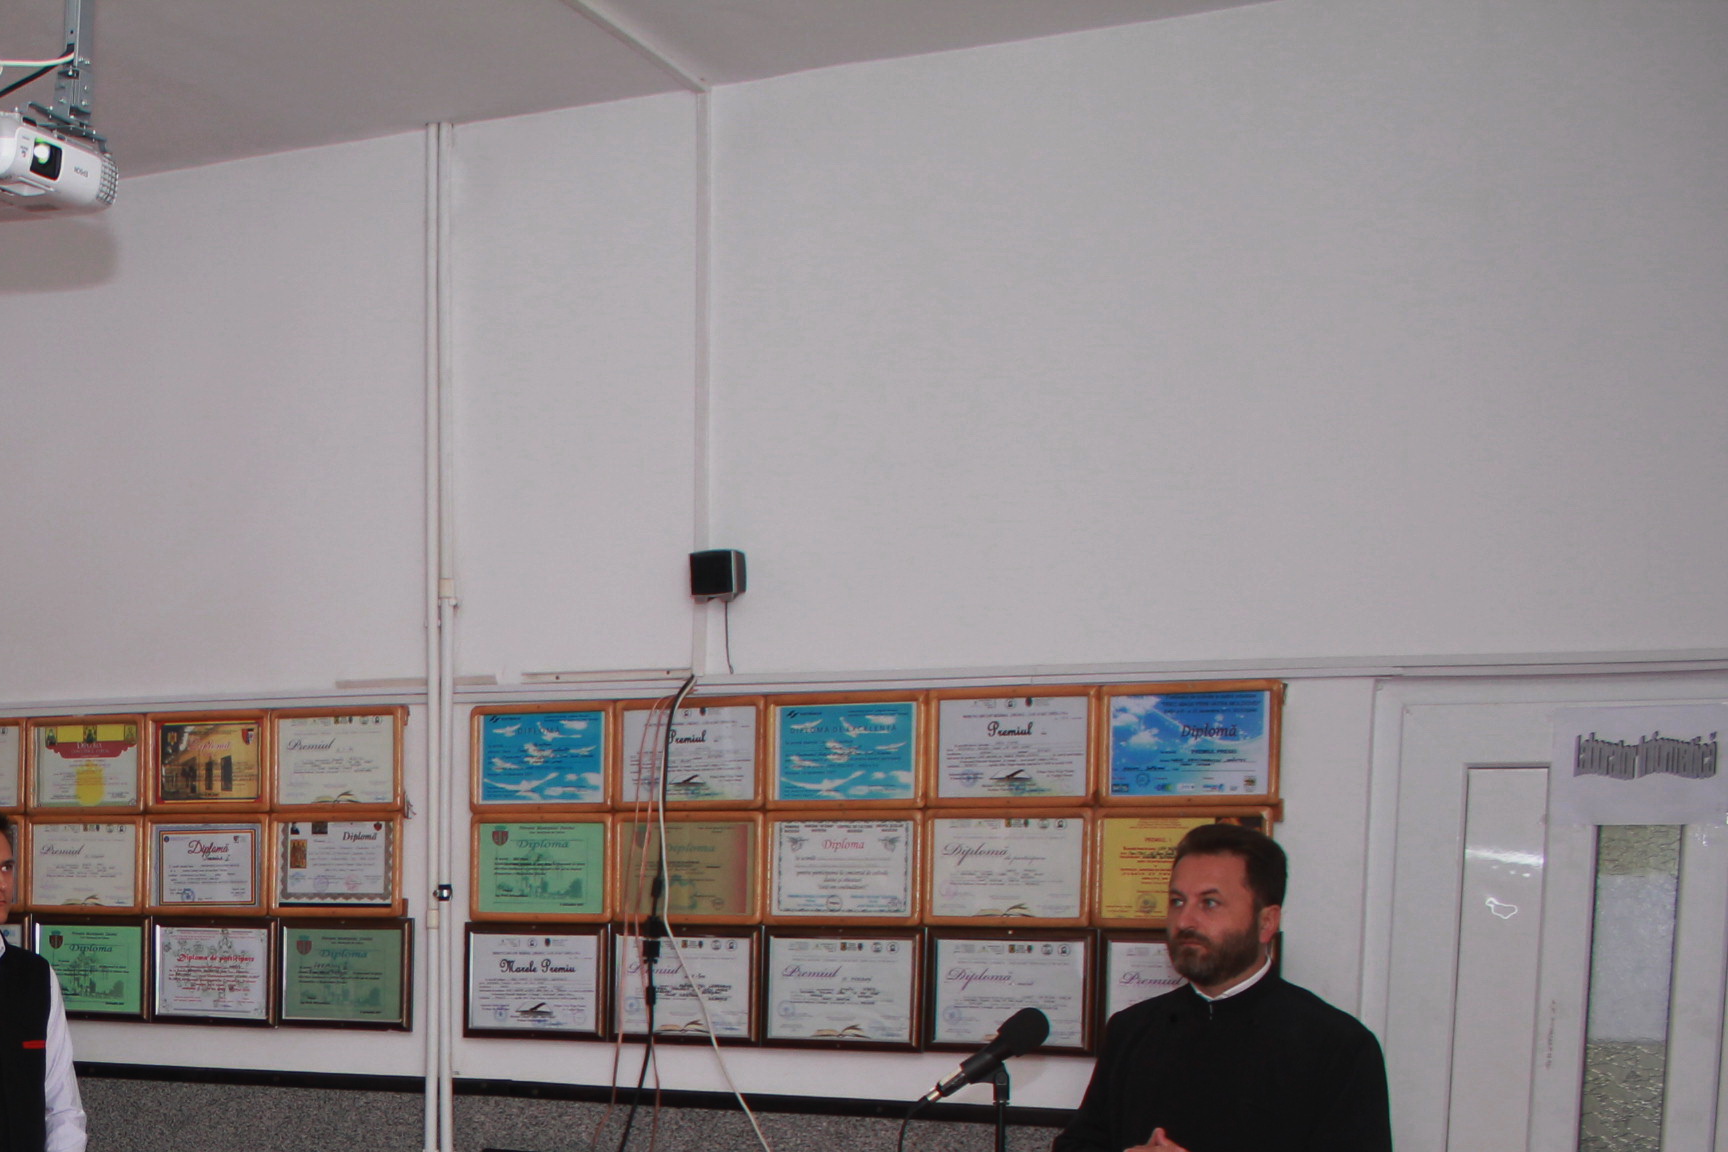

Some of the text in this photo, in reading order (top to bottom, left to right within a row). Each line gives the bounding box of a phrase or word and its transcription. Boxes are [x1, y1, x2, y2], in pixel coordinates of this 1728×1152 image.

[667, 728, 707, 745] Premiul
[986, 720, 1035, 738] Premiul
[1180, 723, 1238, 741] Diplomă
[287, 737, 337, 752] Premiul
[342, 830, 378, 843] Diplomă
[517, 839, 570, 850] Diploma
[40, 843, 86, 856] Premiul
[187, 839, 230, 858] Diplomă
[822, 837, 866, 853] Diploma
[941, 841, 1009, 866] Diplomă
[68, 943, 113, 954] Diploma
[319, 948, 369, 960] Diploma
[498, 957, 577, 974] Marele Premiu
[781, 964, 843, 979] Premiul
[945, 967, 1013, 991] Diplomă
[1118, 970, 1185, 986] Premiul
